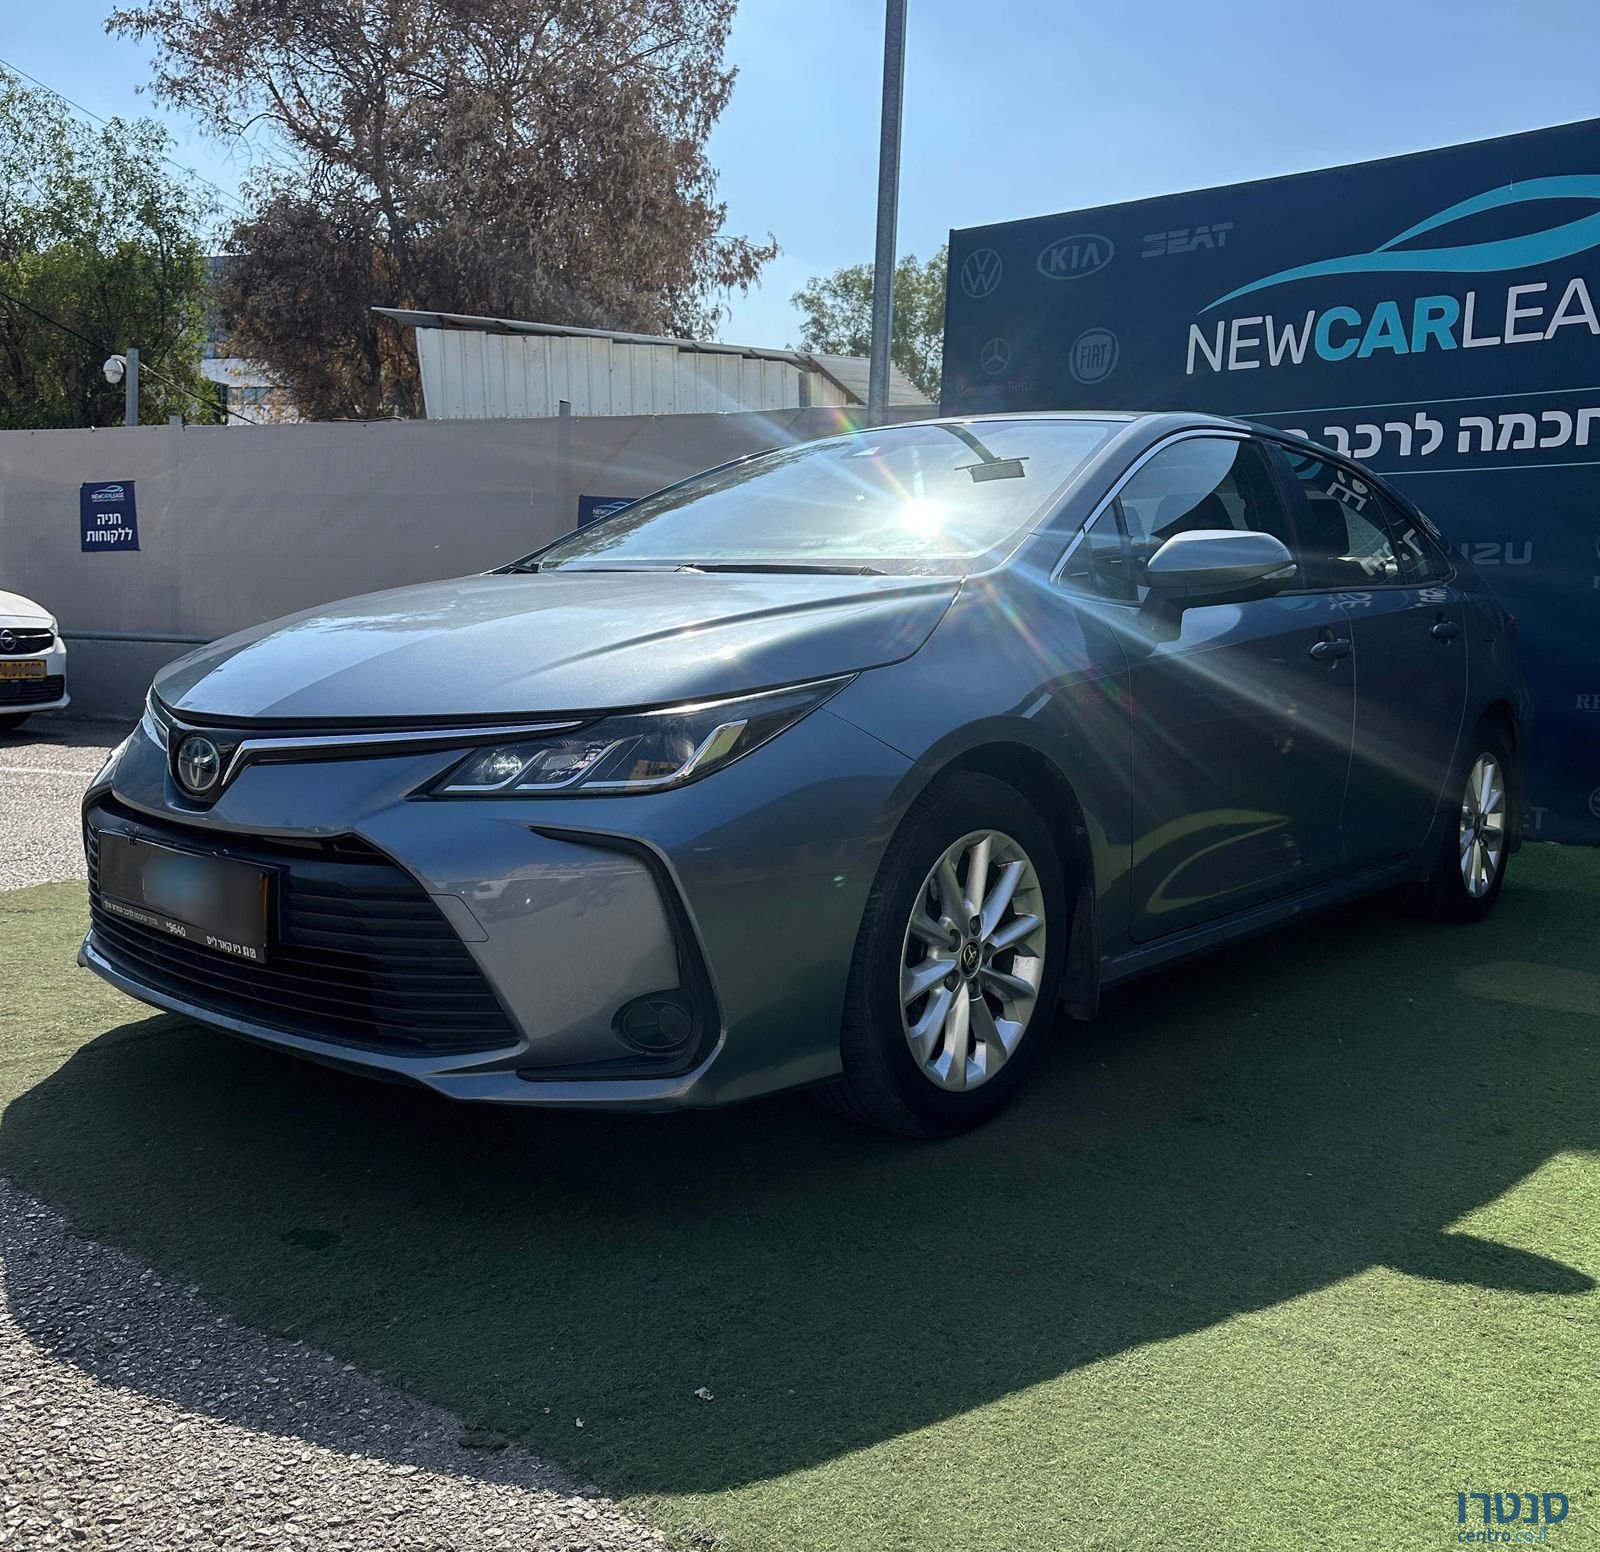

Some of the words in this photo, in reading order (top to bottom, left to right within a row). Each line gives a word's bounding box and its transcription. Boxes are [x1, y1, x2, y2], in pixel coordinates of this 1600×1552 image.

[1141, 222, 1233, 258] SEAT
[1050, 242, 1101, 272] KIA
[1079, 342, 1108, 371] FIAT
[1324, 412, 1444, 459] לרכב
[97, 513, 122, 525] חניה
[86, 527, 133, 544] ללקוחות
